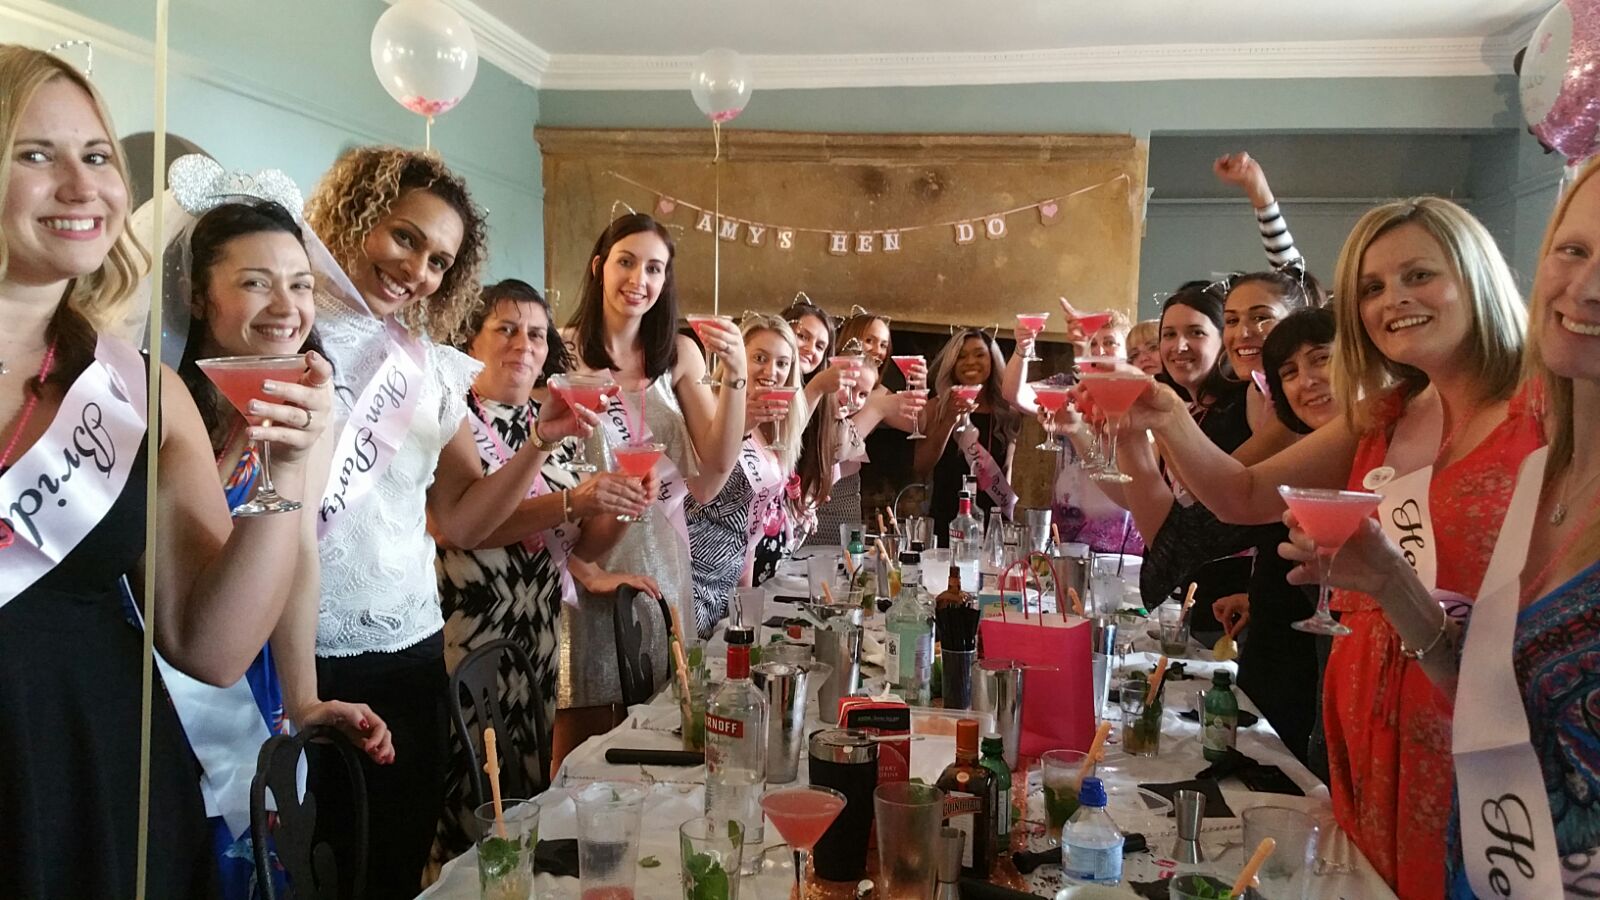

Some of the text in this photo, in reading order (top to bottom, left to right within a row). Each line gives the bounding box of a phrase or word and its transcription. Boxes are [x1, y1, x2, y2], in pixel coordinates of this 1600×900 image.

[696, 213, 1005, 252] AMY'S HEN DO
[608, 394, 631, 443] Hen
[319, 365, 408, 522] Hen Party
[743, 445, 762, 483] Hen
[1391, 498, 1425, 577] He
[705, 716, 737, 734] RNOFF
